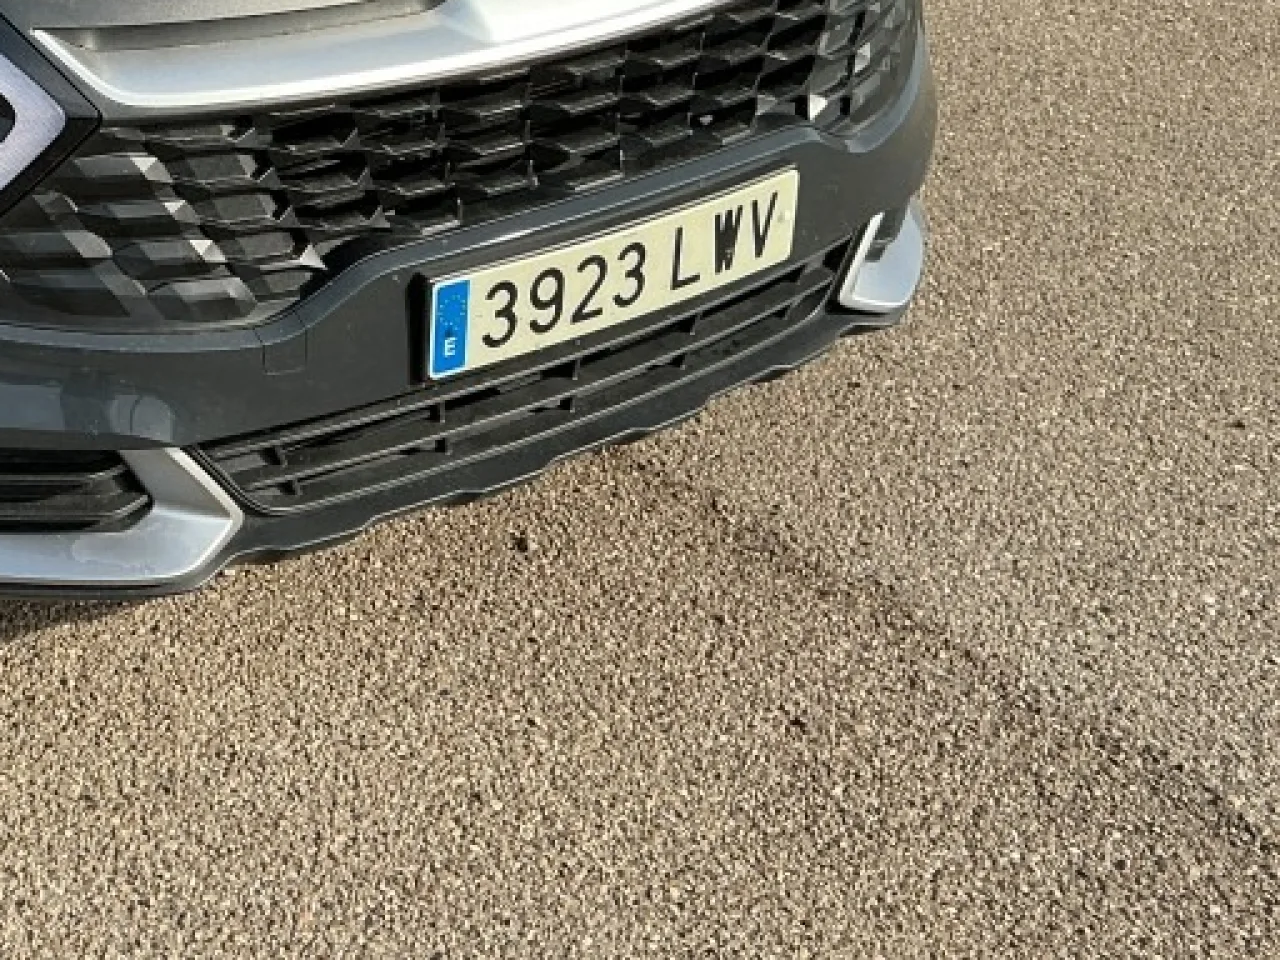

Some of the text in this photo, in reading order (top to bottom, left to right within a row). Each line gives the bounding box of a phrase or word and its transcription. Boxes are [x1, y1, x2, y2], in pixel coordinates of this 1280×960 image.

[481, 191, 778, 349] 3923 LWV
[444, 337, 456, 358] E
